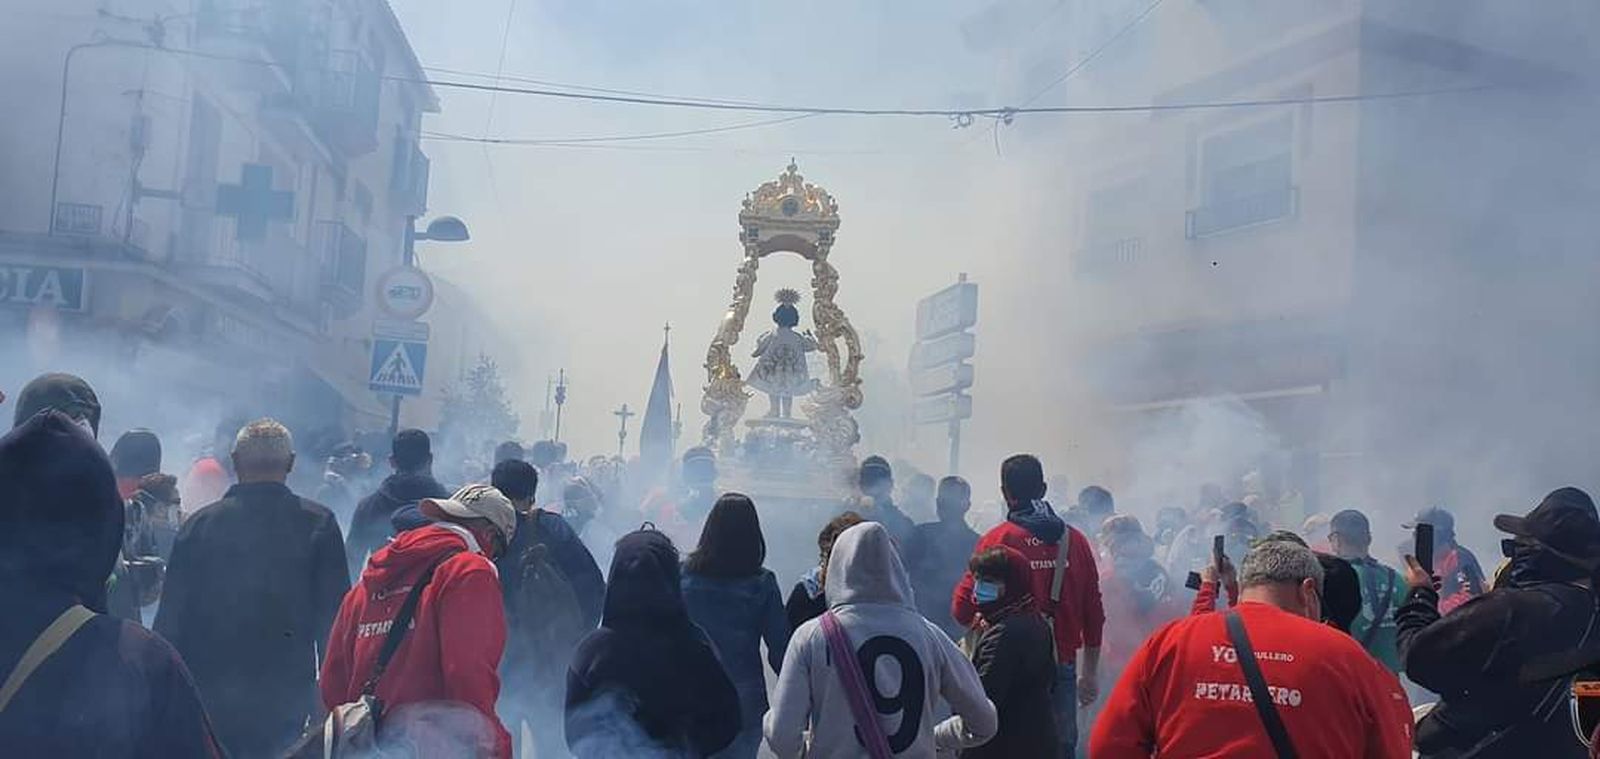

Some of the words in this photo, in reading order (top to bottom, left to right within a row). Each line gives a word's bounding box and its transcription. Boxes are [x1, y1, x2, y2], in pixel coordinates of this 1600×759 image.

[1212, 645, 1238, 664] YO
[1253, 651, 1295, 663] ULLERO
[1195, 682, 1302, 708] PETARERO
